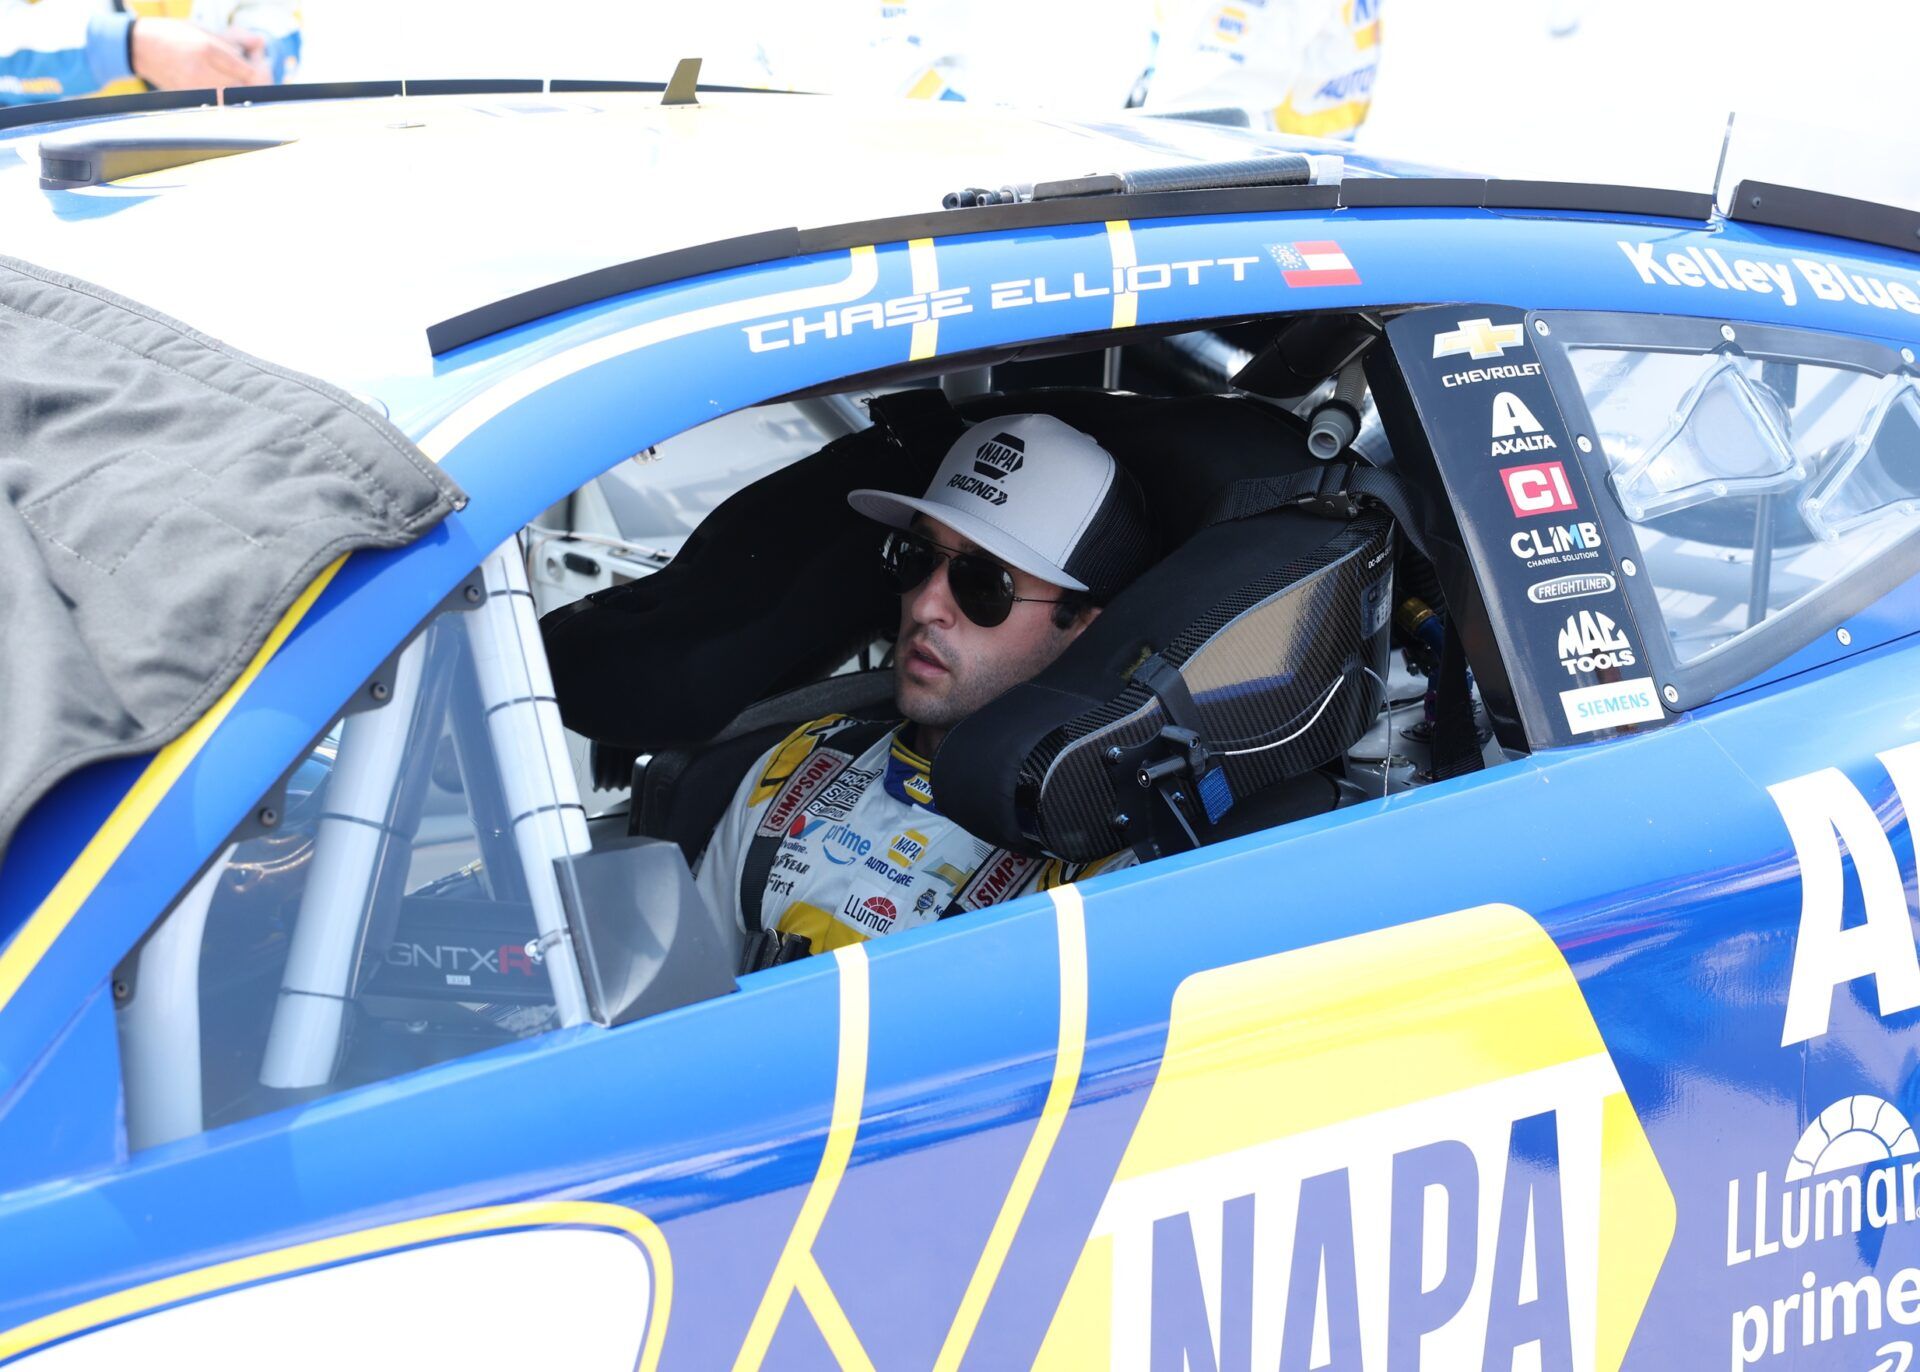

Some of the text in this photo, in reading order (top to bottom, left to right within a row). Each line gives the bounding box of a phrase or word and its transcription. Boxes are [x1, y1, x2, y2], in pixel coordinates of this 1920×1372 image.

[1617, 241, 1920, 315] Kelley Blue
[742, 256, 1260, 354] CHASE ELLIOTT
[1442, 362, 1541, 388] CHEVROLET
[980, 442, 1018, 472] NAPA
[1490, 434, 1557, 456] AXALTA
[946, 473, 998, 501] RACING
[1508, 466, 1573, 510] CI
[1527, 551, 1599, 568] CHANNEL SOLUTIONS
[1538, 577, 1608, 599] FREIGHTLINER
[1558, 610, 1631, 660] MAC
[1561, 650, 1636, 675] TOOLS
[1577, 692, 1650, 718] SIEMENS
[771, 758, 833, 827] SIMPSON
[821, 823, 871, 857] prime
[893, 836, 922, 862] NAPA
[864, 855, 914, 888] AUTO CARE
[976, 852, 1028, 906] SIMPS
[1766, 741, 1920, 1047] A
[843, 894, 894, 934] LLumar
[385, 942, 535, 976] GNTX-R
[1726, 1160, 1920, 1267] LLumar
[1149, 1109, 1574, 1372] NAPA
[1731, 1267, 1920, 1372] prime
